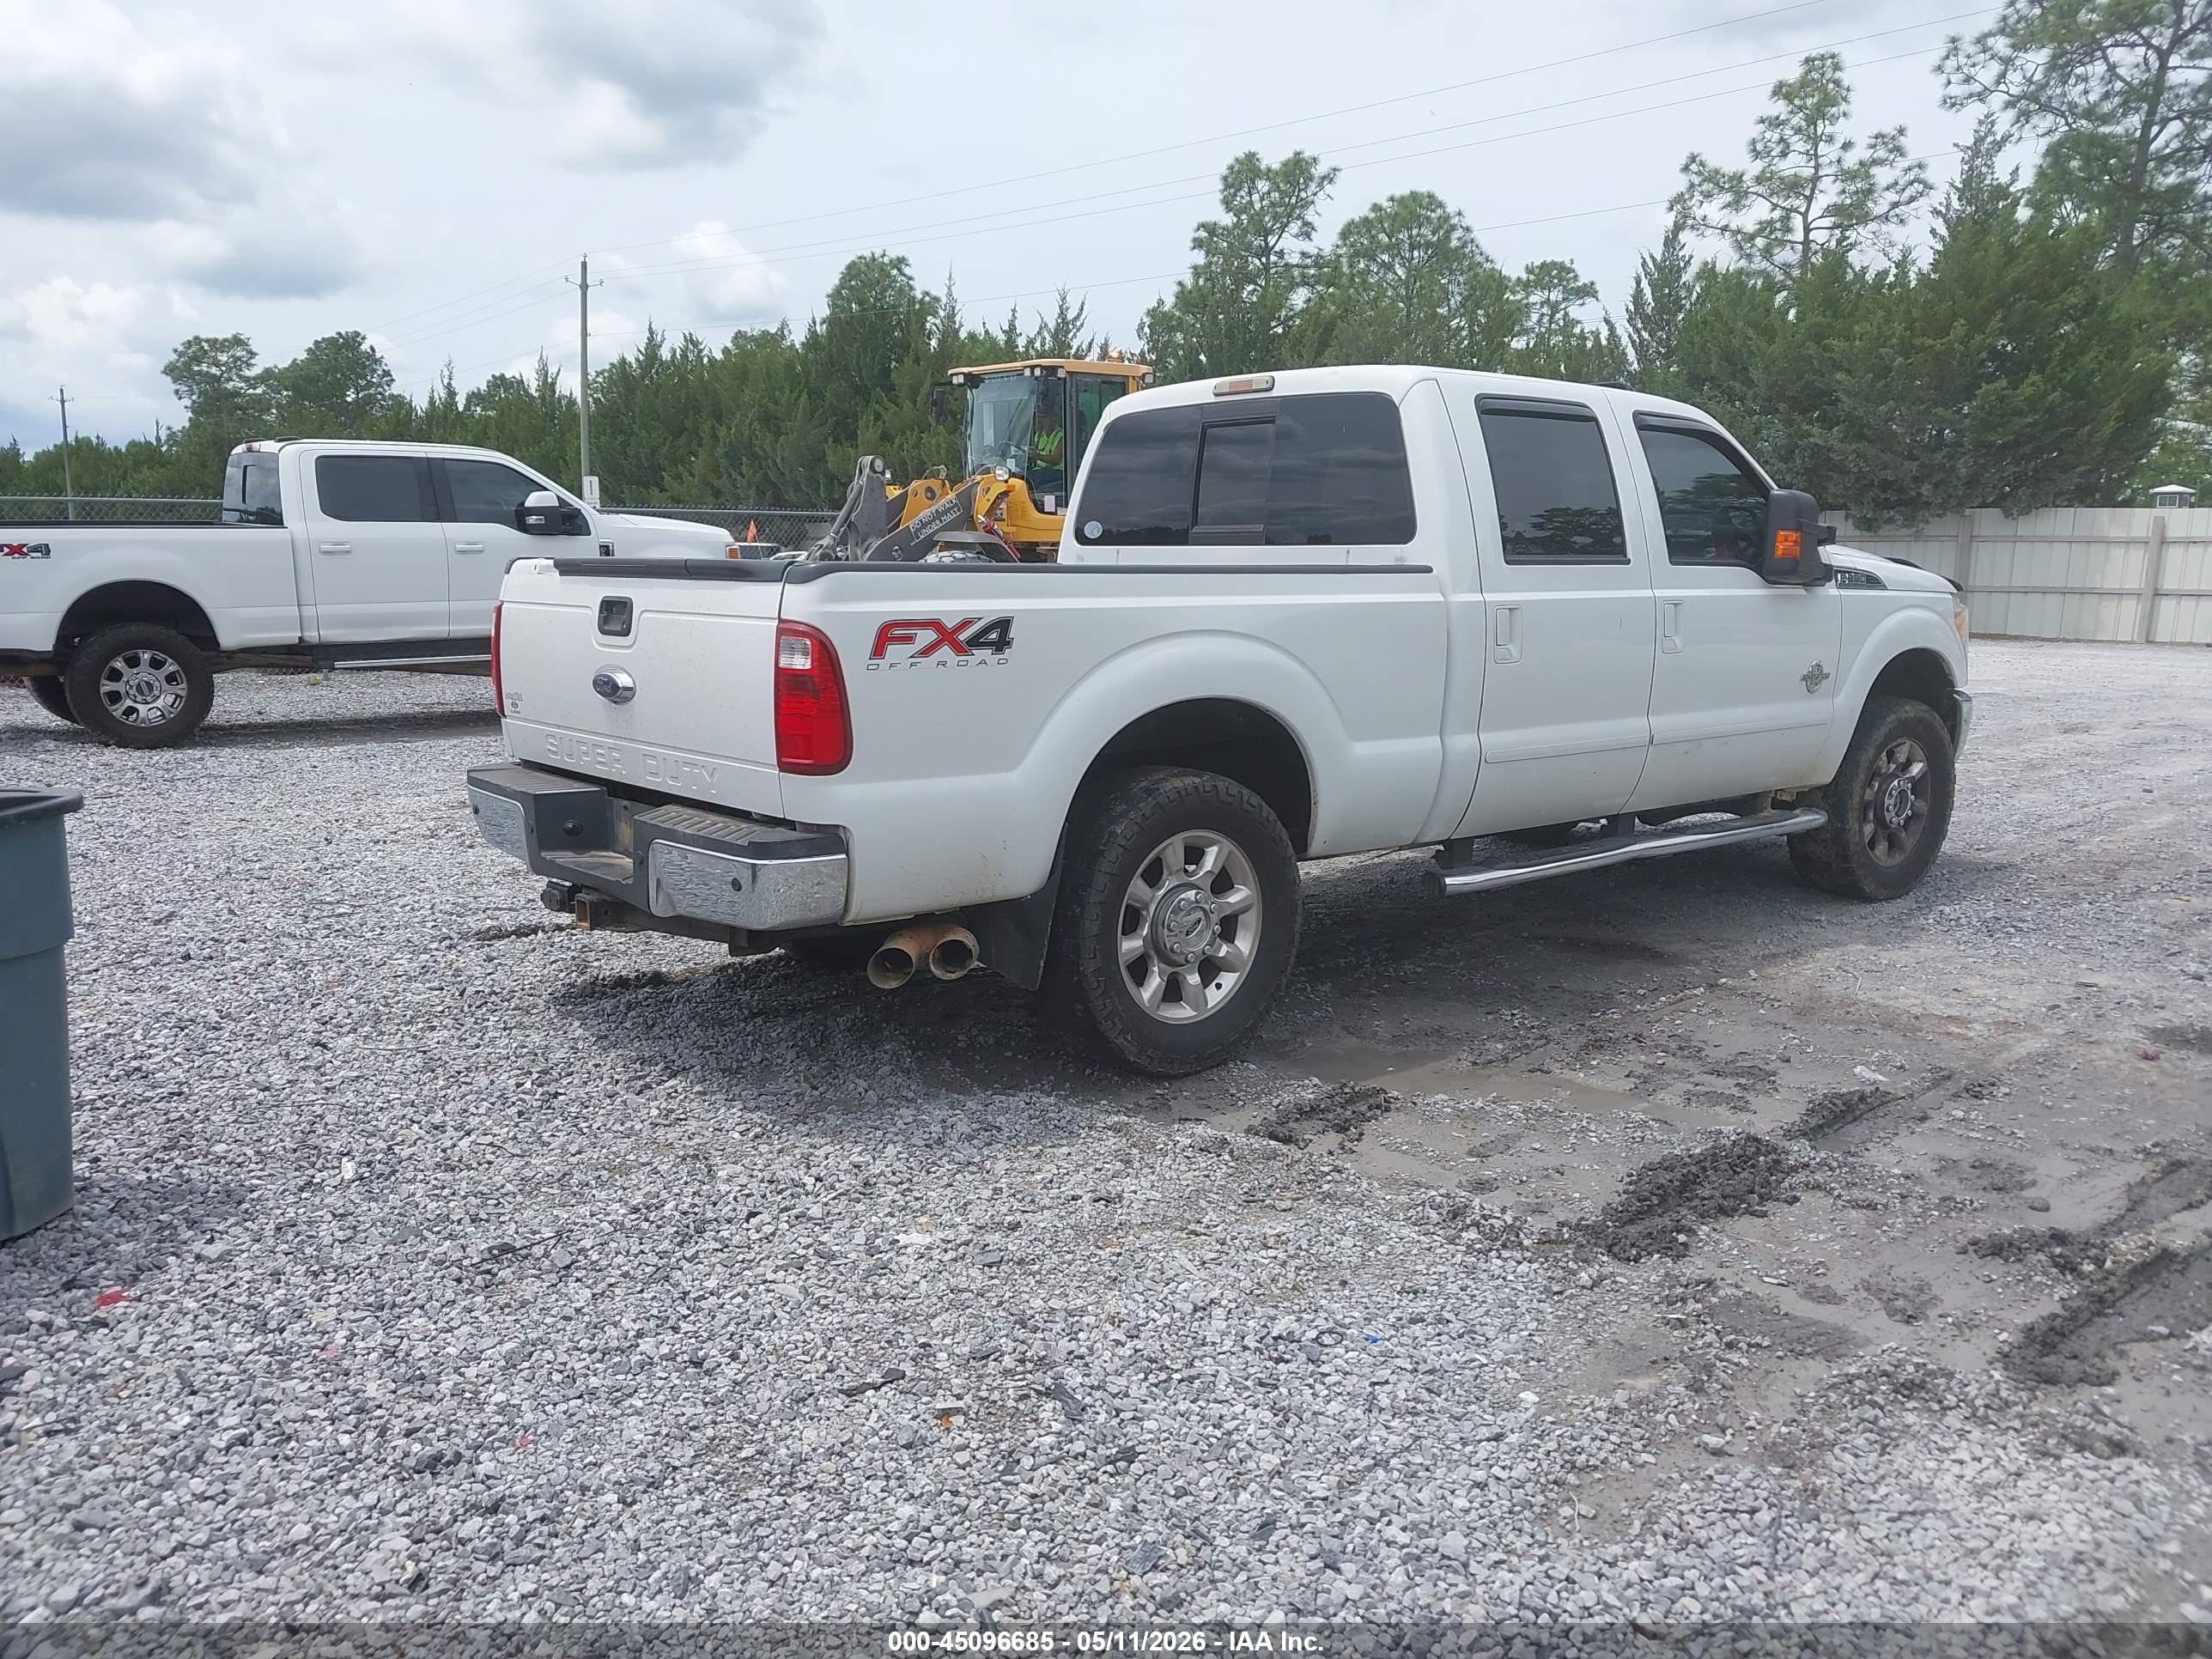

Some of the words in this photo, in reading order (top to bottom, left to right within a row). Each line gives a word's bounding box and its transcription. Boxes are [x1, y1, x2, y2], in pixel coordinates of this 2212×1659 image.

[910, 520, 921, 532] DO
[922, 509, 937, 523] NOT
[938, 496, 958, 514] WALK
[917, 520, 941, 538] UNDER
[941, 507, 959, 523] MAST
[869, 616, 1014, 660] FX4
[866, 661, 921, 671] OFF
[936, 658, 1009, 668] ROAD
[545, 734, 626, 775] SUPER
[642, 749, 719, 793] DUTY
